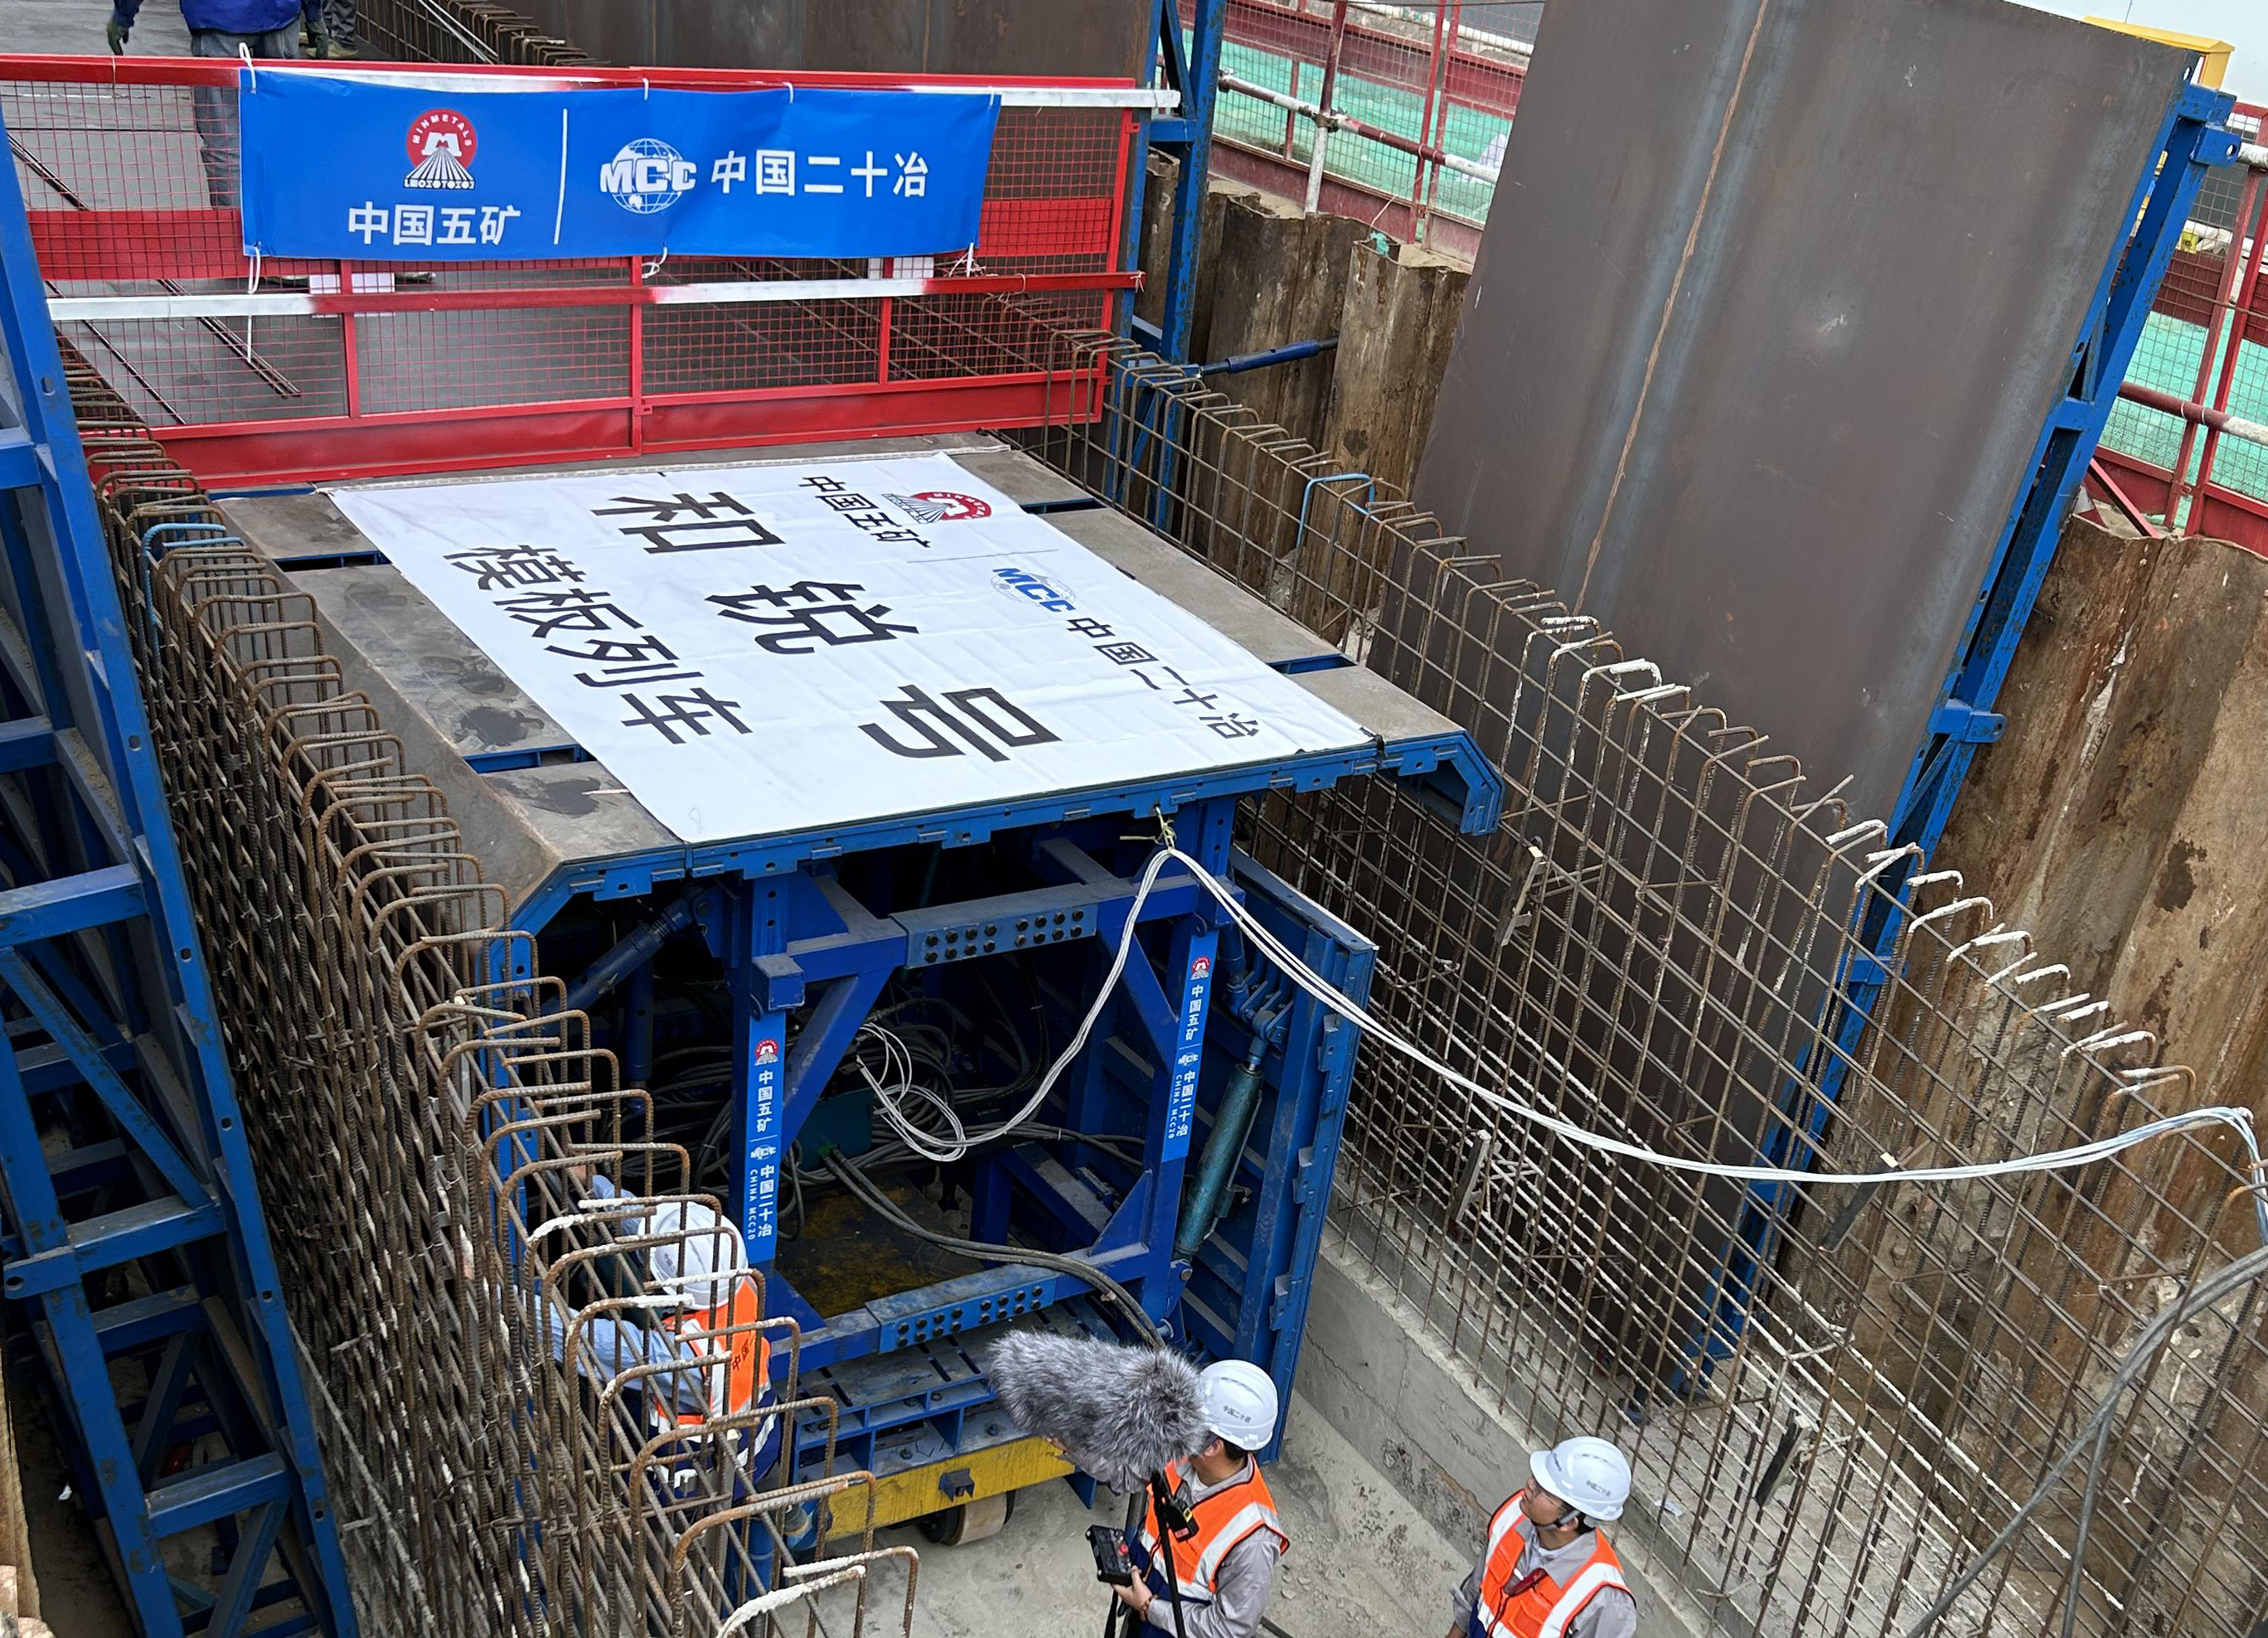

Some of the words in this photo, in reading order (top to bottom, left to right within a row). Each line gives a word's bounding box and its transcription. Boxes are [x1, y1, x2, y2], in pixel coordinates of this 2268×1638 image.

[412, 114, 472, 146] MINMETALS
[600, 158, 697, 194] MCC
[710, 149, 929, 197] 中国二十冶
[348, 201, 521, 245] 中国五矿
[798, 476, 930, 548] 中国五矿
[991, 568, 1075, 613] MCC
[443, 544, 753, 744] 模板列车
[591, 491, 1062, 762] 和锐号
[1066, 617, 1260, 739] 中国二十冶
[1185, 985, 1204, 1041] 中国五矿
[756, 1069, 773, 1132] 中国五矿
[1173, 1075, 1182, 1104] CHINA
[1175, 1071, 1195, 1136] 中国二十冶
[749, 1170, 758, 1202] CHINA
[758, 1165, 774, 1237] 中国二十冶
